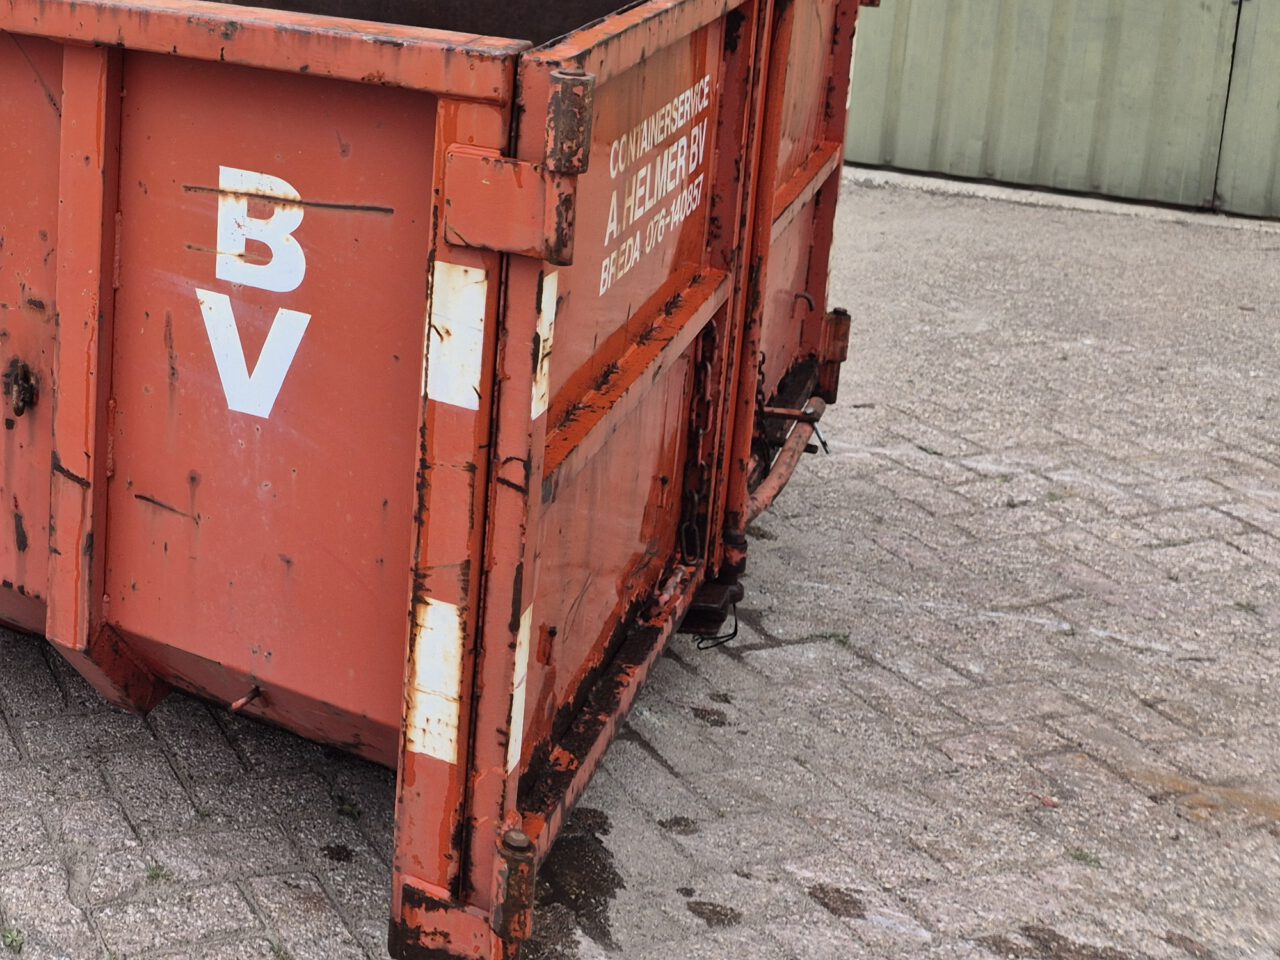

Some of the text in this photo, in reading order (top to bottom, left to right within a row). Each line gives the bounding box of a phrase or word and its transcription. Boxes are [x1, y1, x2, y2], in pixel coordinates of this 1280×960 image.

[610, 74, 710, 179] CONTAINERSERVICE
[623, 135, 688, 232] HELMER
[688, 117, 708, 176] BV
